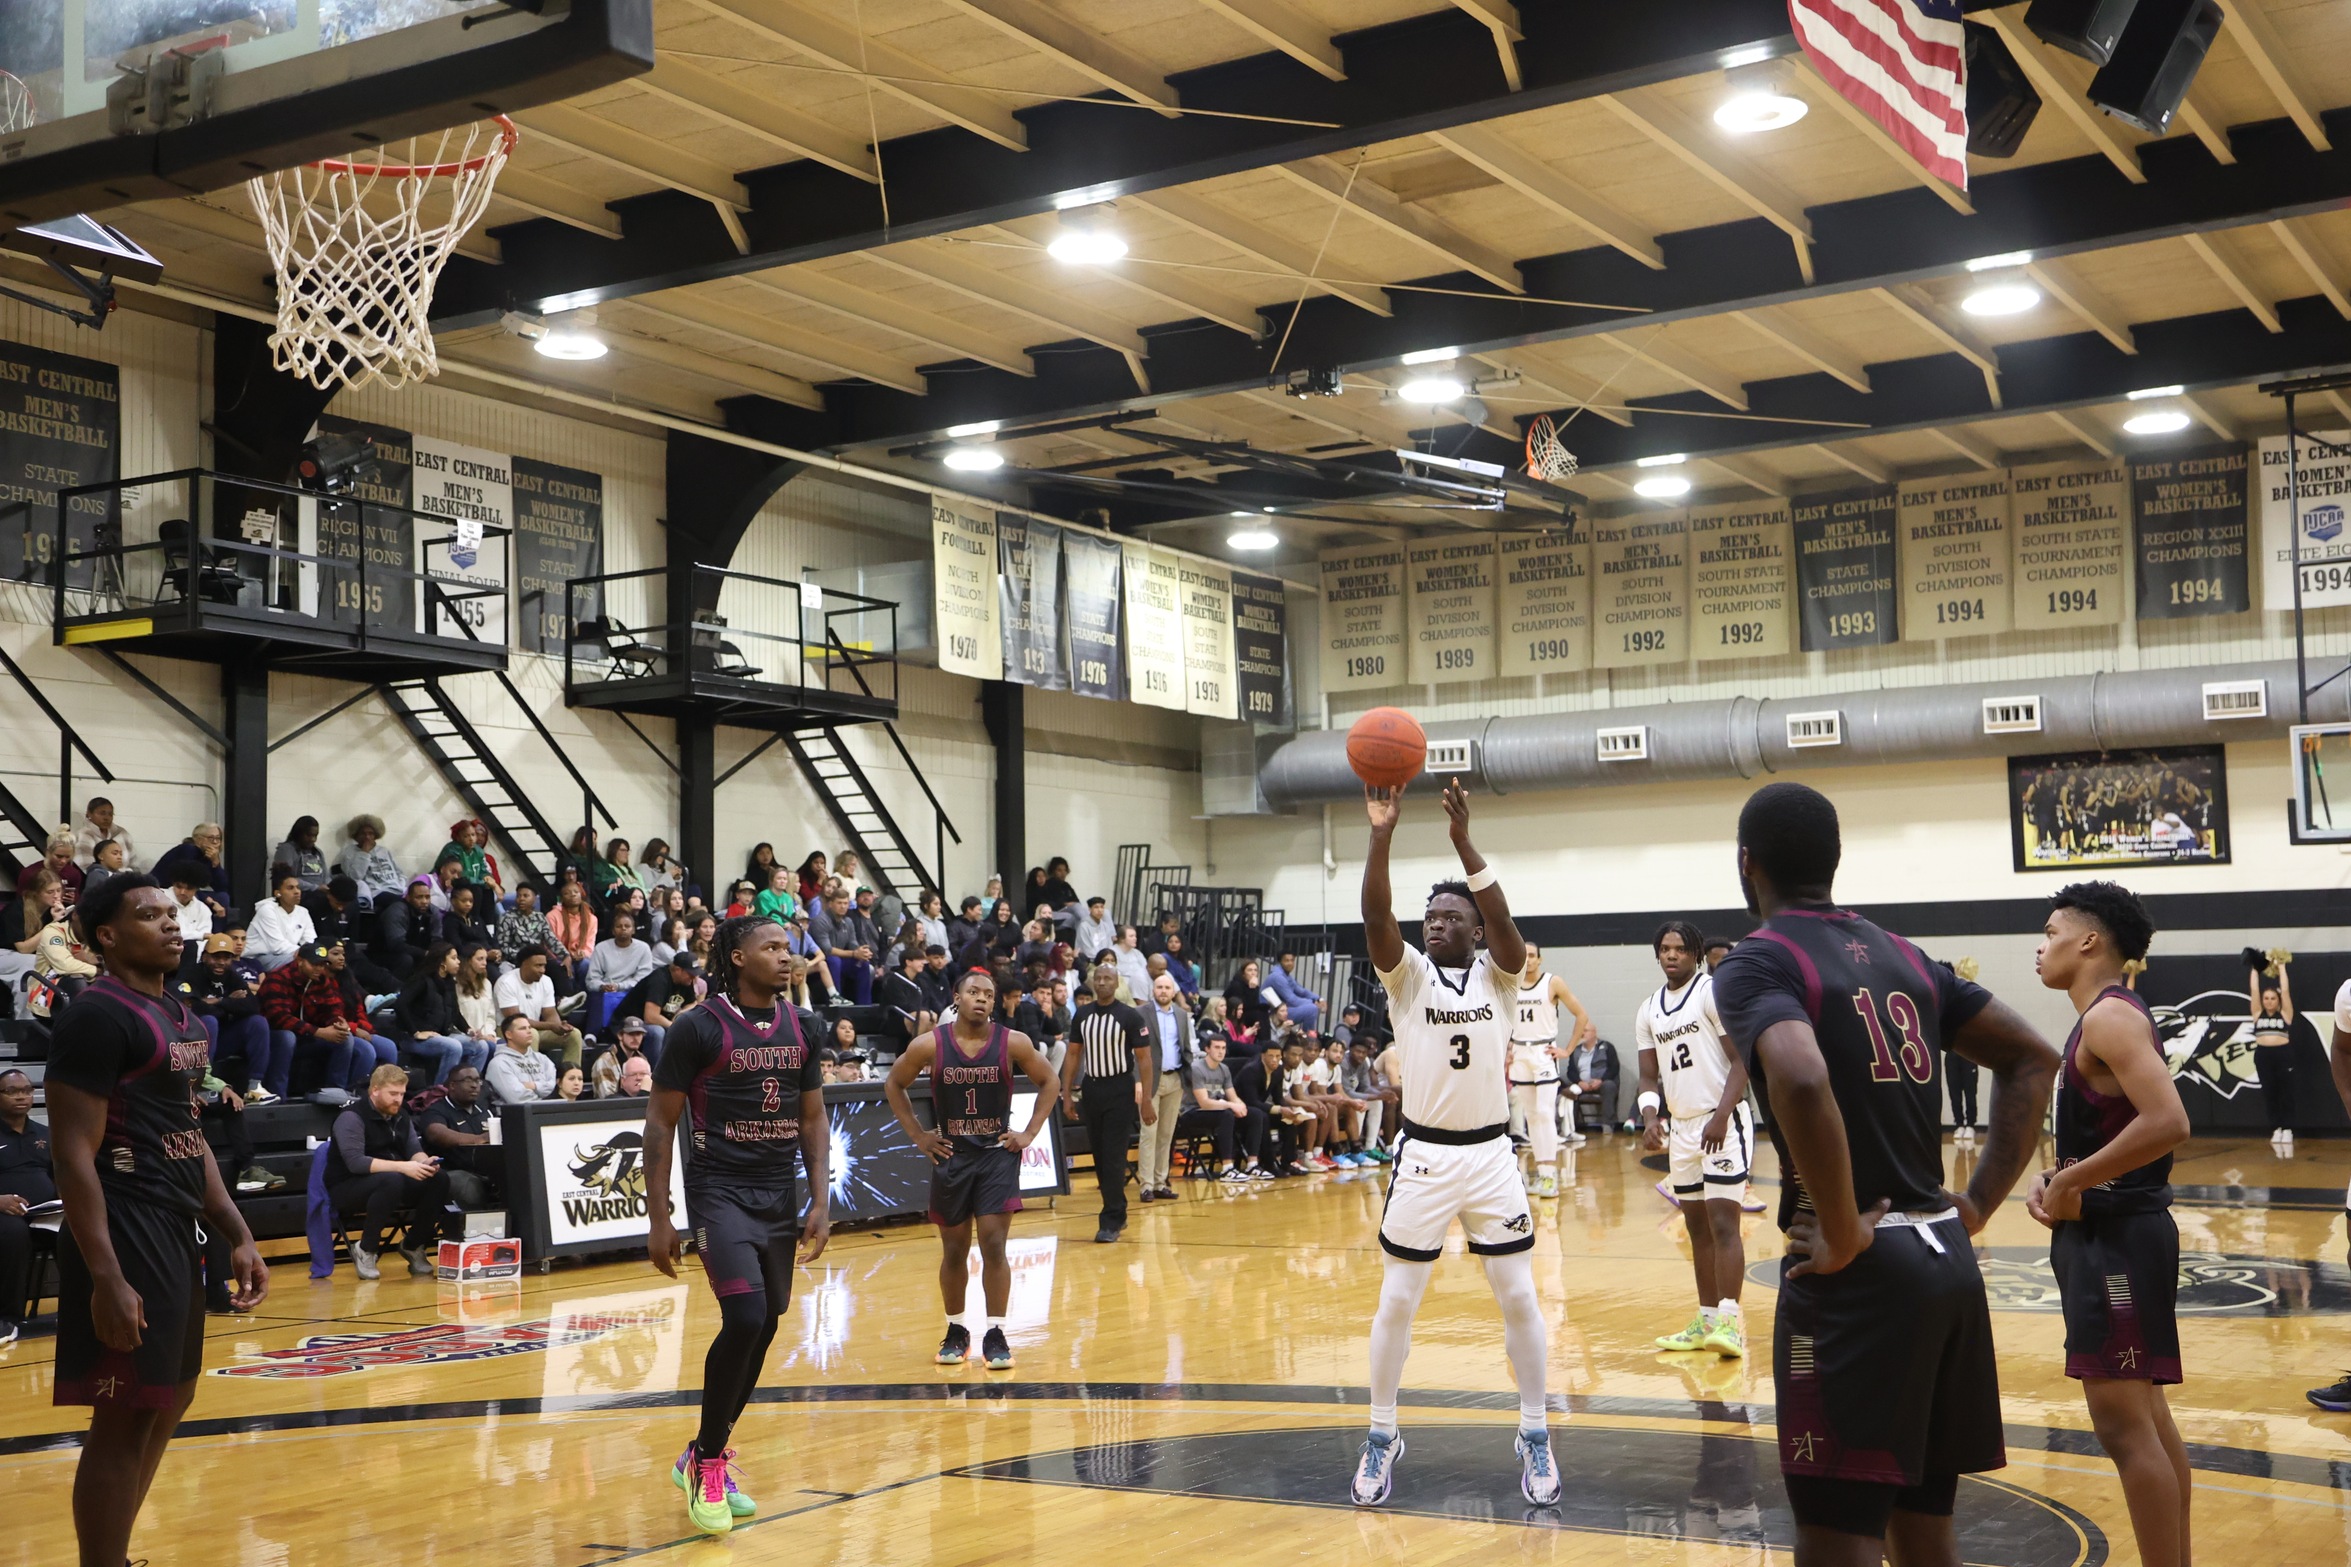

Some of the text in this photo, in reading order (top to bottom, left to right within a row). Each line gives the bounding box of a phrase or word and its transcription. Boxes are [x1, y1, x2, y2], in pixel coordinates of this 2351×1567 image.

[0, 360, 116, 401] AST CENTRAL
[25, 394, 79, 423] MEN'S
[2308, 444, 2351, 460] CENT
[25, 463, 79, 486] STATE
[415, 452, 509, 486] EAST CENTRAL
[2136, 455, 2246, 480] EAST CENTRAL
[513, 472, 600, 504] EAST CENTRAL
[2016, 469, 2123, 493] EAST CENTRAL
[2156, 480, 2227, 498] WOMEN'S
[444, 482, 482, 504] MEN'S
[1902, 482, 2008, 507] EAST CENTRAL
[2047, 493, 2091, 510] MEN'S
[422, 495, 503, 525] BASKETBALL
[530, 501, 585, 525] WOMEN'S
[1795, 496, 1895, 522] EAST CENTRAL
[2144, 492, 2241, 516] BASKETBALL
[1693, 510, 1788, 531] EAST CENTRAL
[1934, 506, 1977, 523] MEN'S
[2024, 506, 2117, 527] BASKETBALL
[2303, 509, 2344, 531] NJCAA
[379, 528, 398, 543] VII
[520, 514, 595, 542] BASKETBALL
[1597, 521, 1686, 542] EAST CENTRAL
[1824, 520, 1866, 538] MEN'S
[1911, 518, 2002, 540] BASKETBALL
[2022, 527, 2120, 547] SOUTH STATE
[2144, 524, 2244, 546] REGION XXIII
[1502, 532, 1589, 553] EAST CENTRAL
[1720, 534, 1760, 548] MEN'S
[1804, 530, 1890, 554] BASKETBALL
[1933, 541, 1981, 557] SOUTH
[1410, 543, 1495, 563] EAST CENTRAL
[1518, 552, 1573, 570] WOMEN'S
[1624, 544, 1660, 559] MEN'S
[1700, 545, 1782, 564] BASKETBALL
[2020, 544, 2124, 565] TOURNAMENT
[2147, 543, 2242, 564] CHAMPIONS
[540, 559, 576, 578] STATE
[1322, 552, 1404, 573] EAST CENTRAL
[1426, 563, 1479, 579] WOMEN'S
[1603, 555, 1682, 574] BASKETBALL
[1827, 564, 1869, 580] STATE
[1926, 558, 1991, 575] DIVISION
[2027, 563, 2118, 582] CHAMPIONS
[1180, 570, 1199, 585] EAST
[1200, 575, 1230, 593] CENTRAL
[1338, 573, 1389, 589] WOMEN'S
[1509, 565, 1585, 584] BASKETBALL
[1622, 576, 1664, 590] SOUTH
[1698, 565, 1784, 582] SOUTH STATE
[1916, 574, 2003, 593] CHAMPIONS
[521, 577, 594, 599] CHAMPONS
[1328, 585, 1400, 602] BASKETBALL
[1417, 576, 1490, 593] BASKETBALL
[1526, 586, 1567, 600] SOUTH
[1696, 582, 1786, 599] TOURNAMENT
[1808, 578, 1891, 599] CHAMPIONS
[2170, 578, 2223, 605] 1994
[1253, 589, 1284, 605] CENTRAL
[1433, 596, 1472, 609] SOUTH
[1616, 592, 1671, 607] DIVISION
[1702, 599, 1782, 615] CHAMPIONS
[2048, 588, 2097, 613] 1994
[1184, 604, 1226, 624] BASKETBALL
[1344, 605, 1383, 618] SOUTH
[1428, 611, 1480, 626] DIVISION
[1521, 601, 1575, 616] DIVISION
[1606, 607, 1682, 624] CHAMPIONS
[1937, 598, 1984, 623] 1994
[1081, 611, 1106, 627] STATE
[1237, 616, 1280, 635] BASKETBALL
[1347, 620, 1381, 633] STATE
[1512, 616, 1585, 633] CHAMPIONS
[1829, 610, 1876, 637] 1993
[1071, 627, 1115, 647] CHAMPIONS
[1194, 626, 1218, 640] SOUTH
[1331, 634, 1400, 650] CHAMPIONS
[1420, 626, 1489, 642] CHAMPIONS
[1623, 630, 1665, 652] 1992
[1721, 622, 1763, 645] 1992
[1195, 644, 1217, 656] STATE
[1250, 646, 1270, 659] STATE
[1436, 648, 1474, 669] 1989
[1529, 639, 1569, 661] 1990
[1081, 660, 1106, 686] 1976
[1185, 657, 1226, 674] CHAMPIONS
[1239, 660, 1280, 677] CHAMPIONS
[1347, 656, 1384, 677] 1980
[1146, 670, 1167, 693] 1976
[1195, 681, 1219, 702] 1979
[1249, 691, 1273, 712] 1979
[1425, 1004, 1493, 1026] WARRIORS
[1521, 1009, 1533, 1022] 14
[1853, 987, 1932, 1084] 13
[731, 1046, 801, 1072] SOUTH
[1450, 1034, 1470, 1070] 3
[1671, 1043, 1693, 1072] 12
[944, 1066, 998, 1084] SOUTH
[762, 1077, 780, 1112] 2
[966, 1088, 977, 1114] 1
